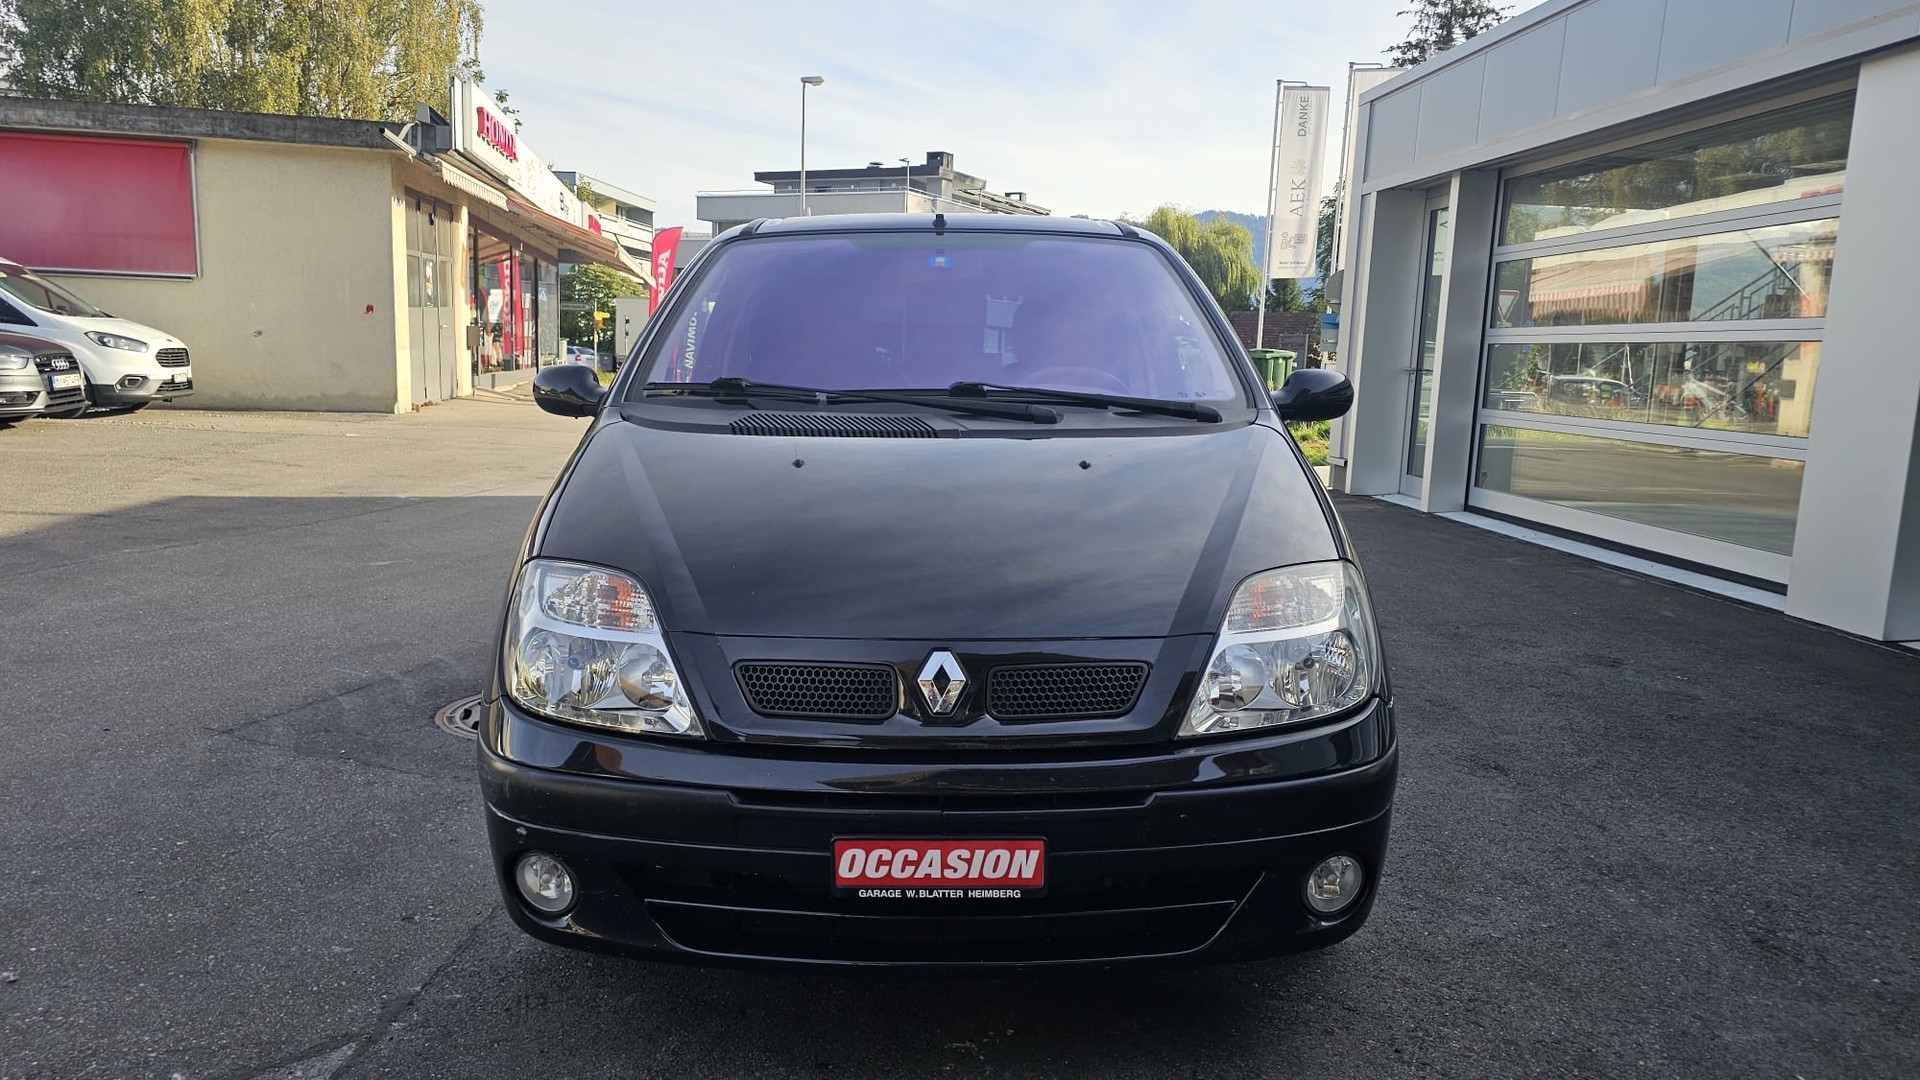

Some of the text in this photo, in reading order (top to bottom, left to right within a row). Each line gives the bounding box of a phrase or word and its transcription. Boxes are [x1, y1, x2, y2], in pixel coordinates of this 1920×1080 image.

[477, 107, 518, 161] HONDA
[1298, 95, 1310, 137] DANKE
[1289, 177, 1306, 217] AEK
[684, 311, 698, 370] NAVIMO
[838, 848, 1040, 879] OCCASION
[858, 889, 902, 898] GARAGE
[968, 889, 1021, 898] HEIMBERG
